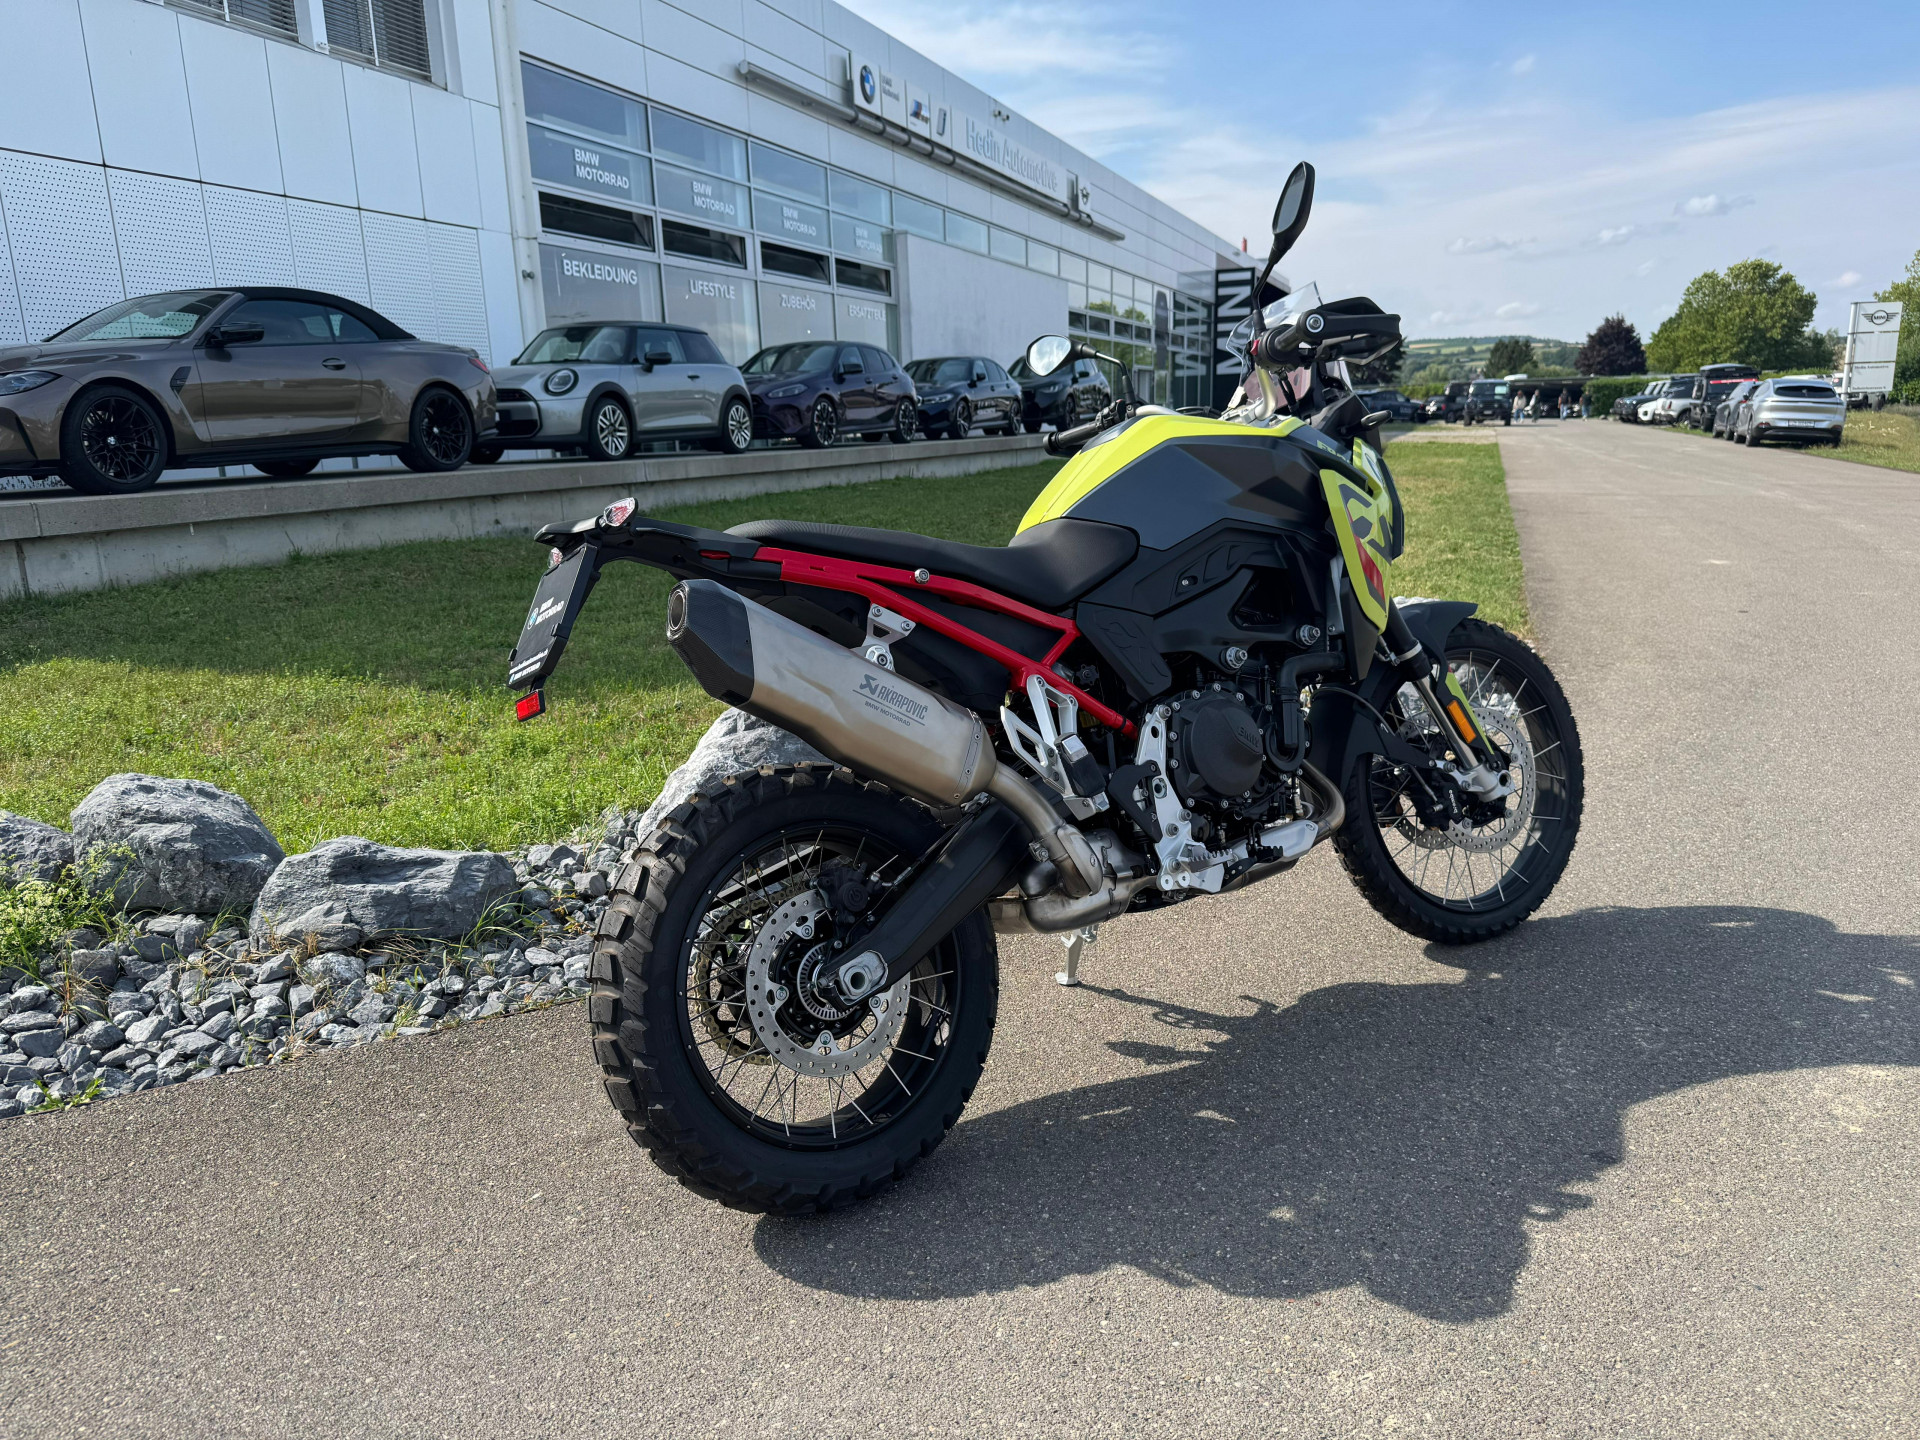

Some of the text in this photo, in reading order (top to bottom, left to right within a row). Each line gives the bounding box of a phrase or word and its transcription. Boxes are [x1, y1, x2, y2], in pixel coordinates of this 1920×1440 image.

[574, 148, 600, 167] BMW
[965, 116, 1058, 193] Hedin Automotive
[576, 165, 630, 190] MOTORRAD
[692, 181, 712, 196] BMW
[693, 195, 735, 216] MOTORRAD
[782, 206, 799, 220] BMW
[783, 218, 817, 237] MOTORRAD
[562, 258, 638, 286] BEKLEIDUNG
[689, 278, 736, 300] LIFESTYLE
[781, 292, 816, 311] ZUBEHÖR
[848, 303, 886, 322] ERSATZTEILE
[864, 700, 911, 726] BMW MOTORRAD
[877, 685, 929, 720] AKRAPOVIČ
